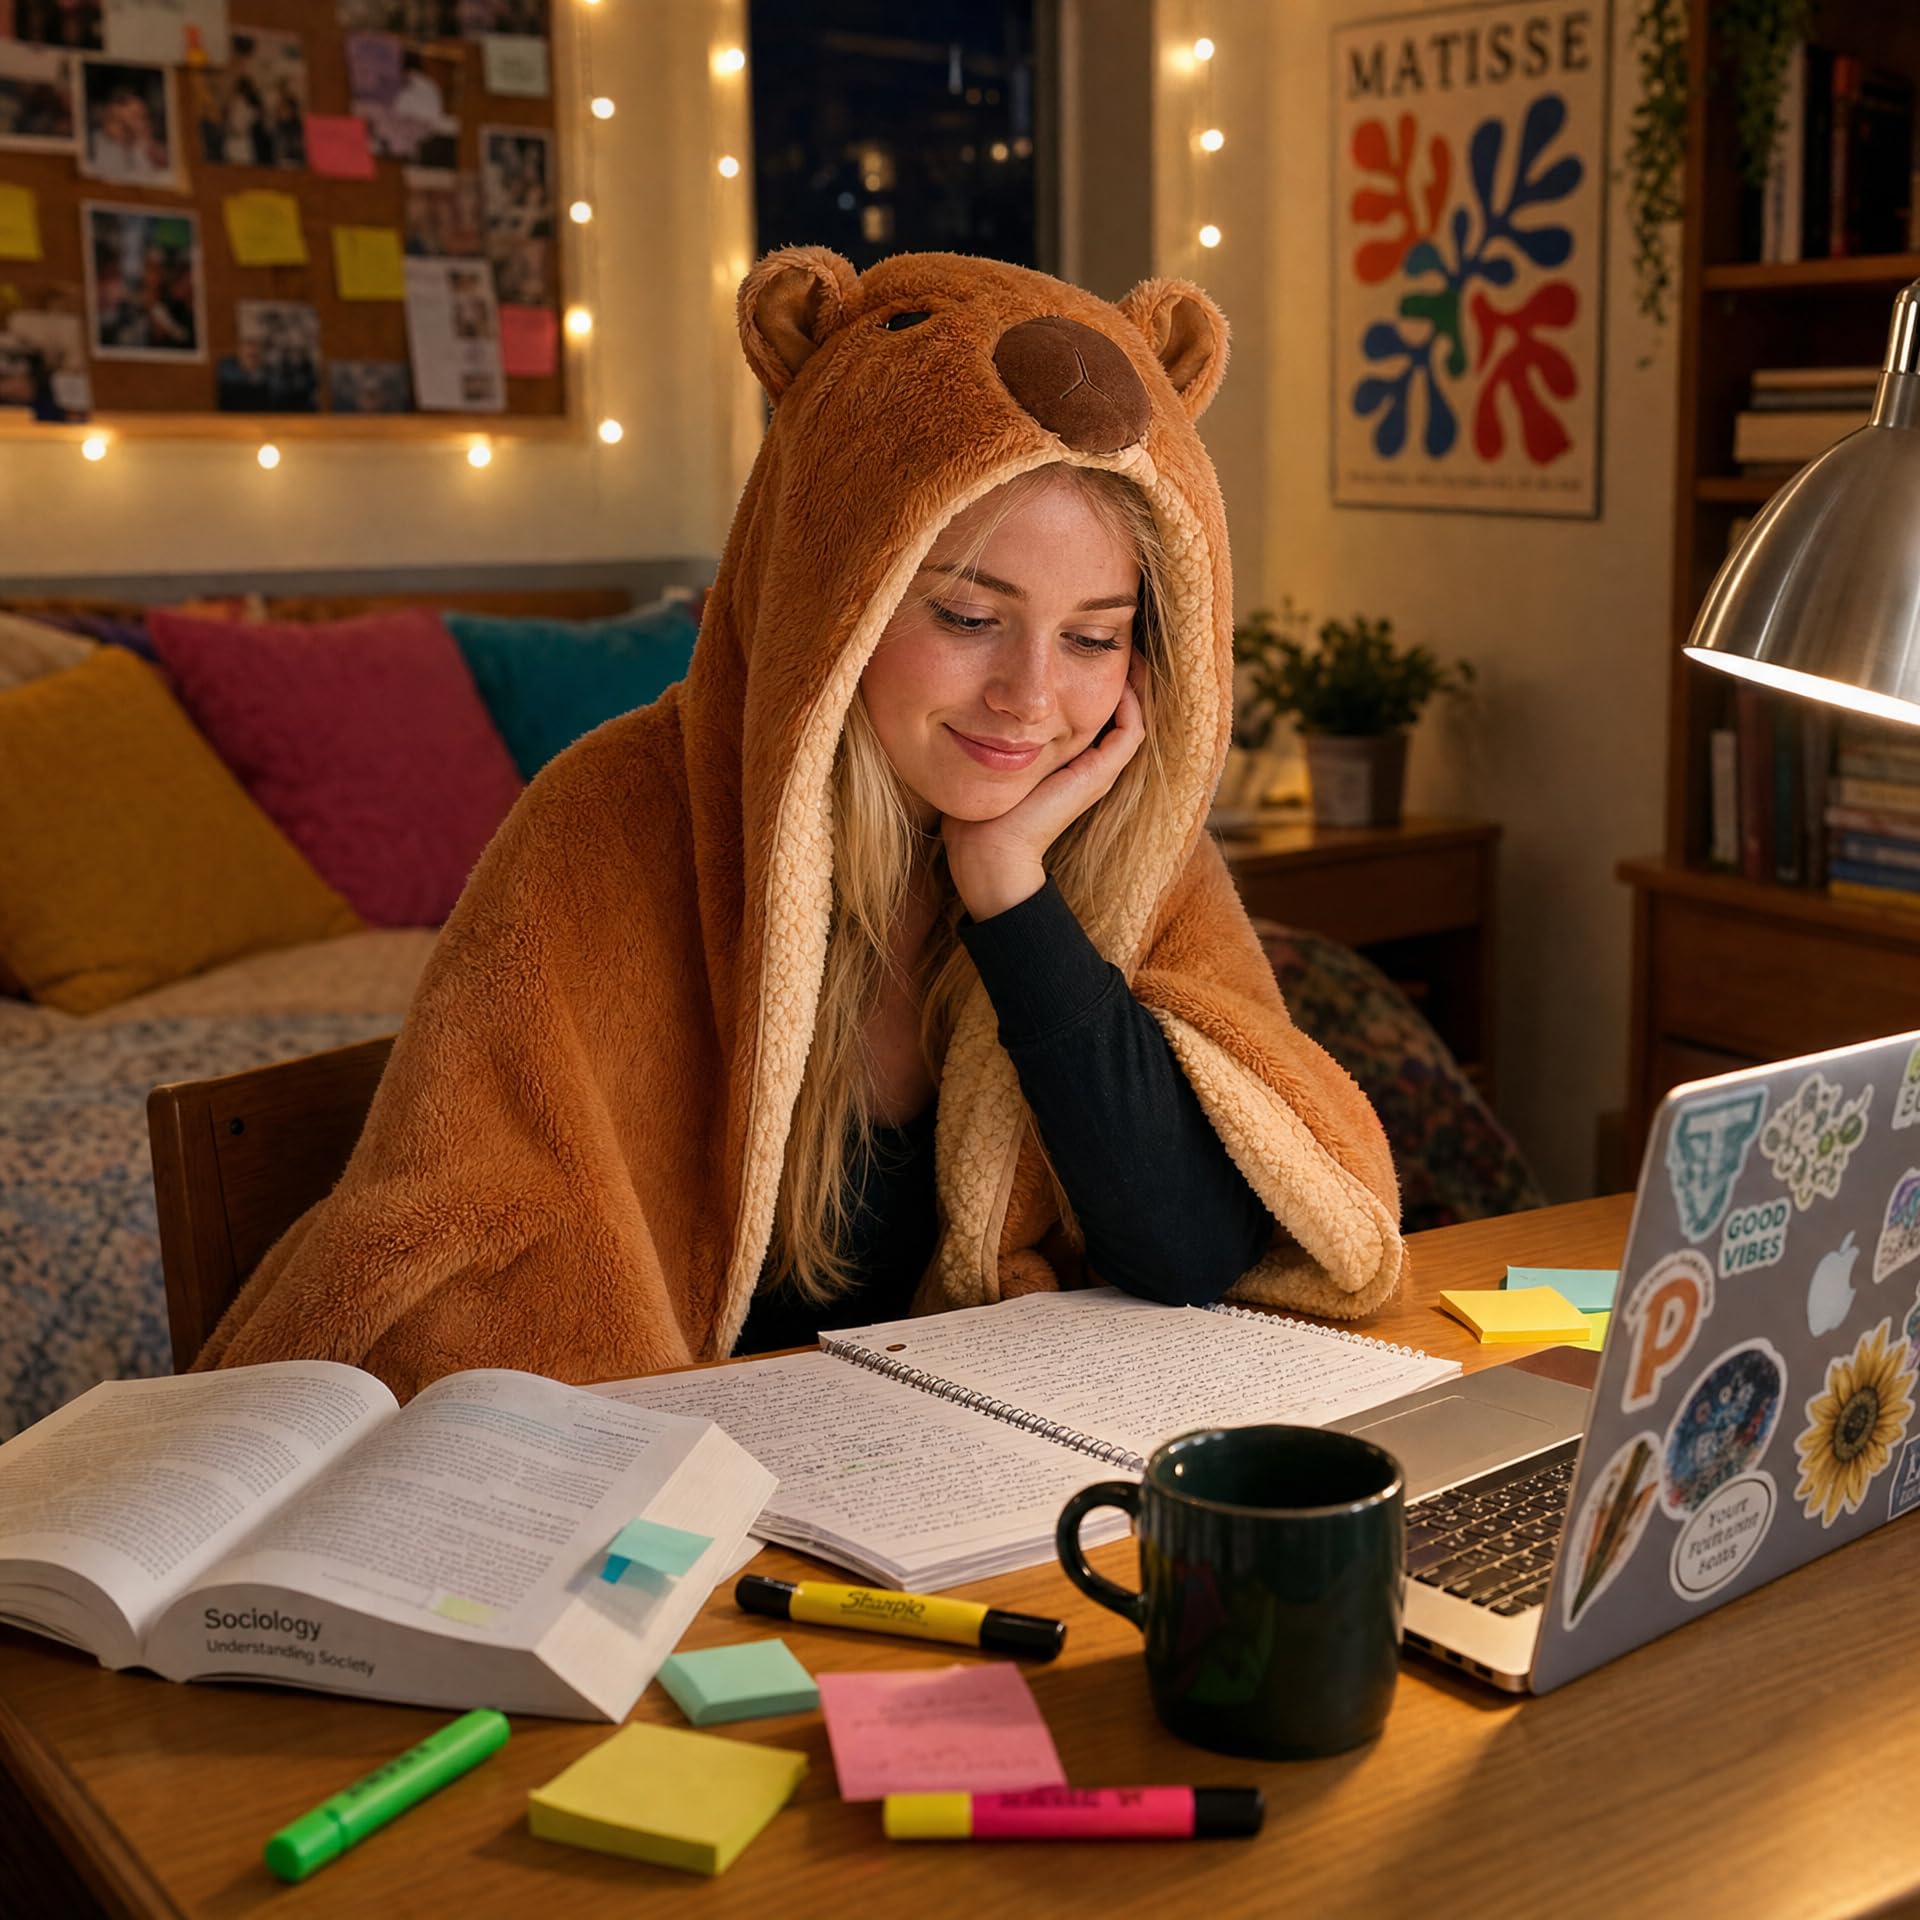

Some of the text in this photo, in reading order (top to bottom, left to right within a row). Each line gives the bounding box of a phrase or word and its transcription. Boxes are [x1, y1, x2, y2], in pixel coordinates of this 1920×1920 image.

[1349, 10, 1591, 98] MATISSE
[1728, 1203, 1786, 1240] GOOD
[1724, 1234, 1781, 1271] VIBES
[1631, 1277, 1699, 1401] P
[204, 1608, 322, 1641] Sociology
[206, 1639, 375, 1677] Understanding Society
